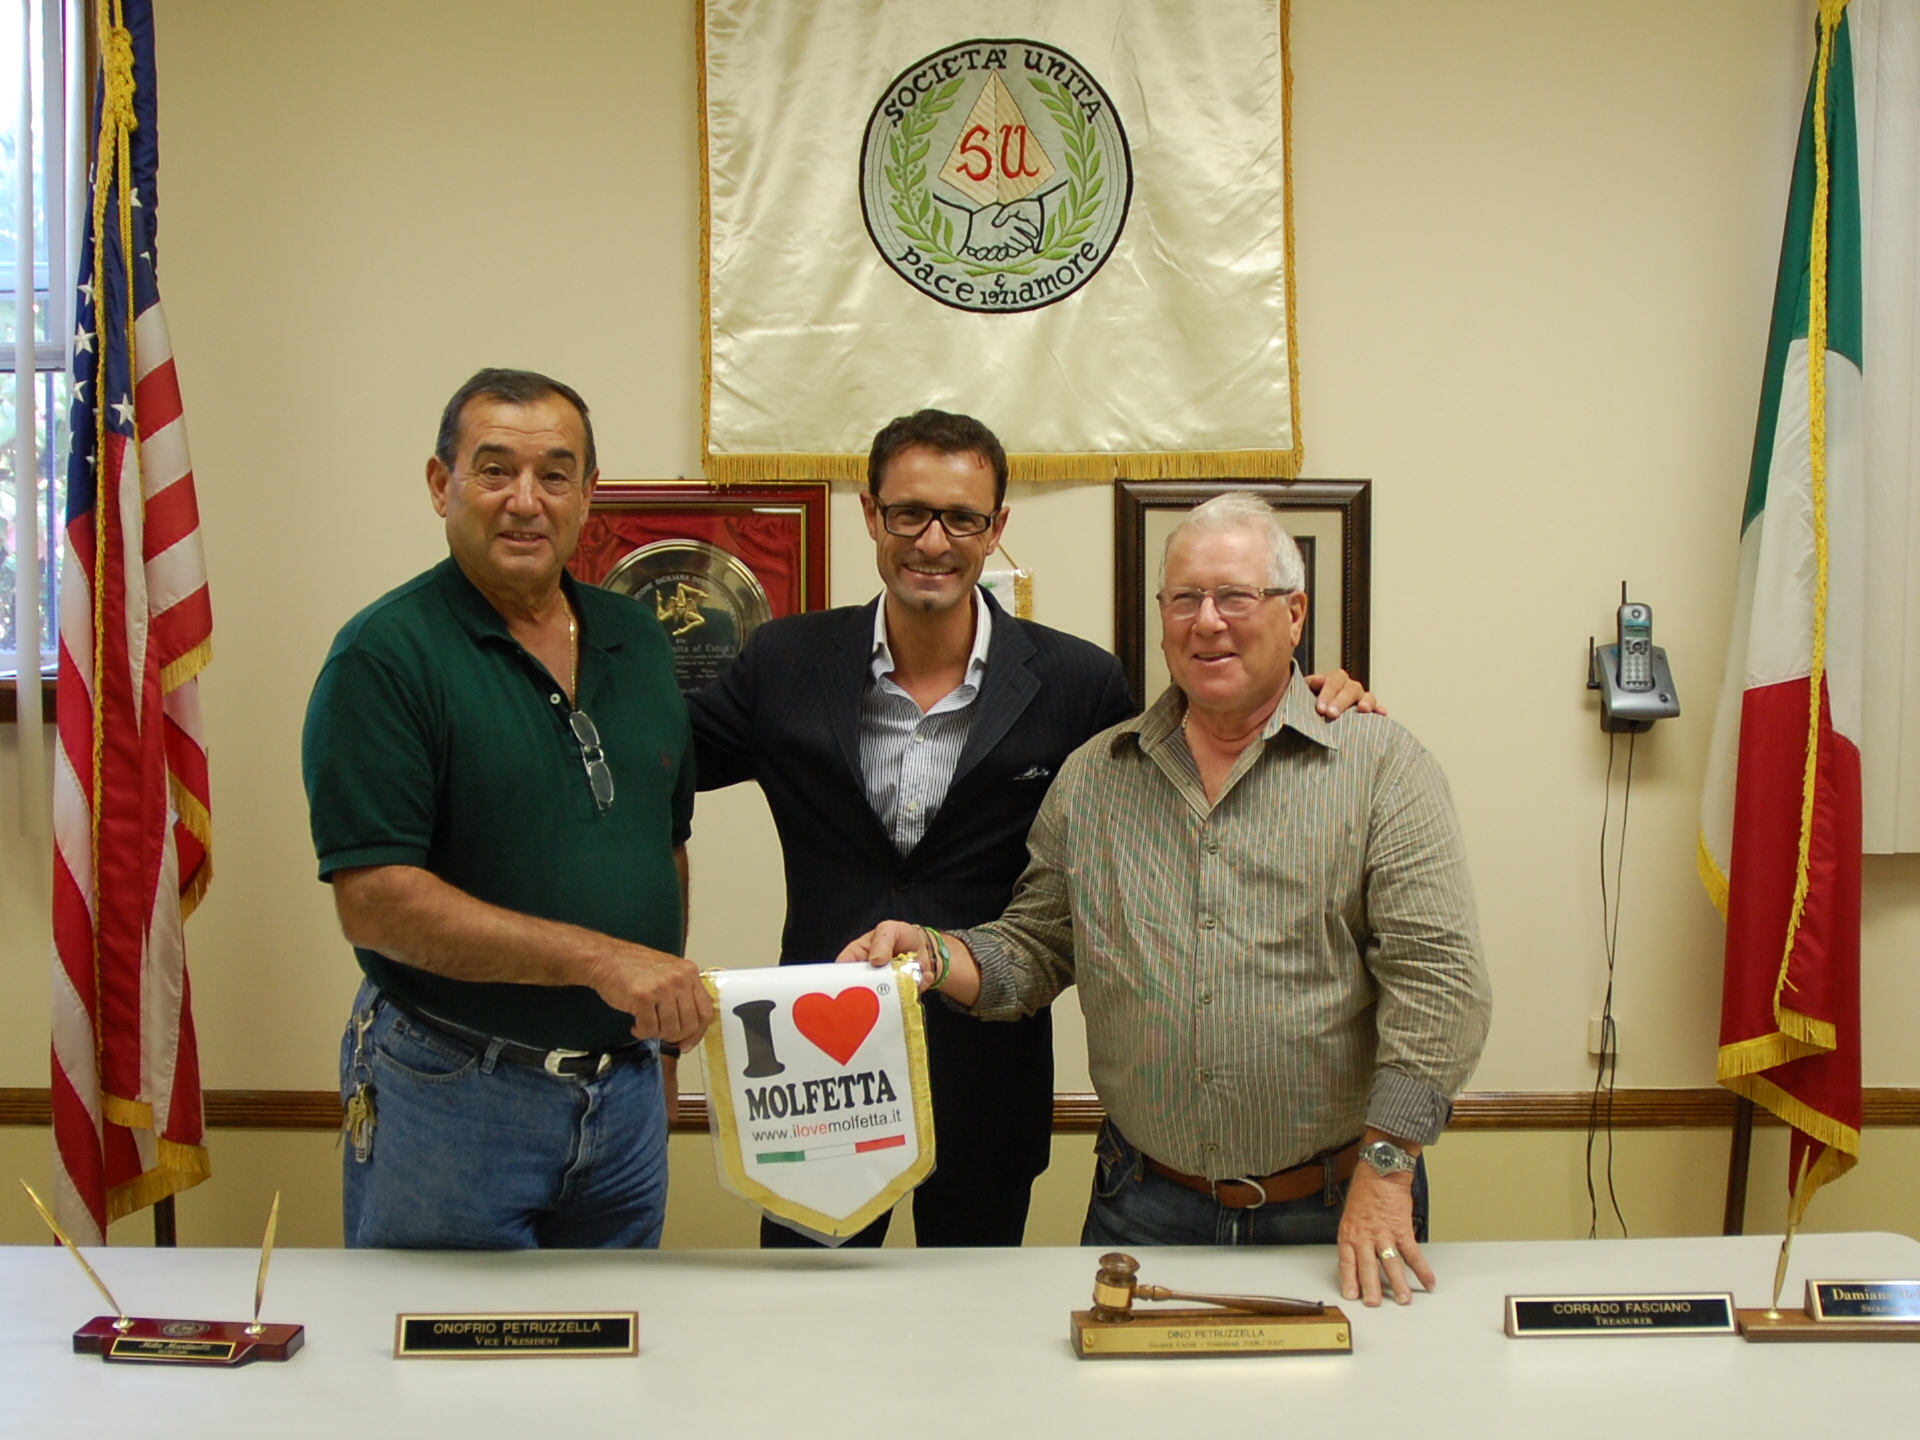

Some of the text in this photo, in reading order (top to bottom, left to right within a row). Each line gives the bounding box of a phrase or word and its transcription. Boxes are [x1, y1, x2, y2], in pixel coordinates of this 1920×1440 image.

[980, 290, 1019, 304] 1971
[732, 999, 786, 1078] I
[744, 1069, 897, 1121] MOLFETTA
[752, 1109, 902, 1142] www.ilovemolfetta.it
[1553, 1301, 1691, 1315] CORRADO FASCIANO
[433, 1321, 601, 1334] ONOFRIO PETRUZZELLA
[1167, 1329, 1265, 1340] DINO PETRUZZELLA
